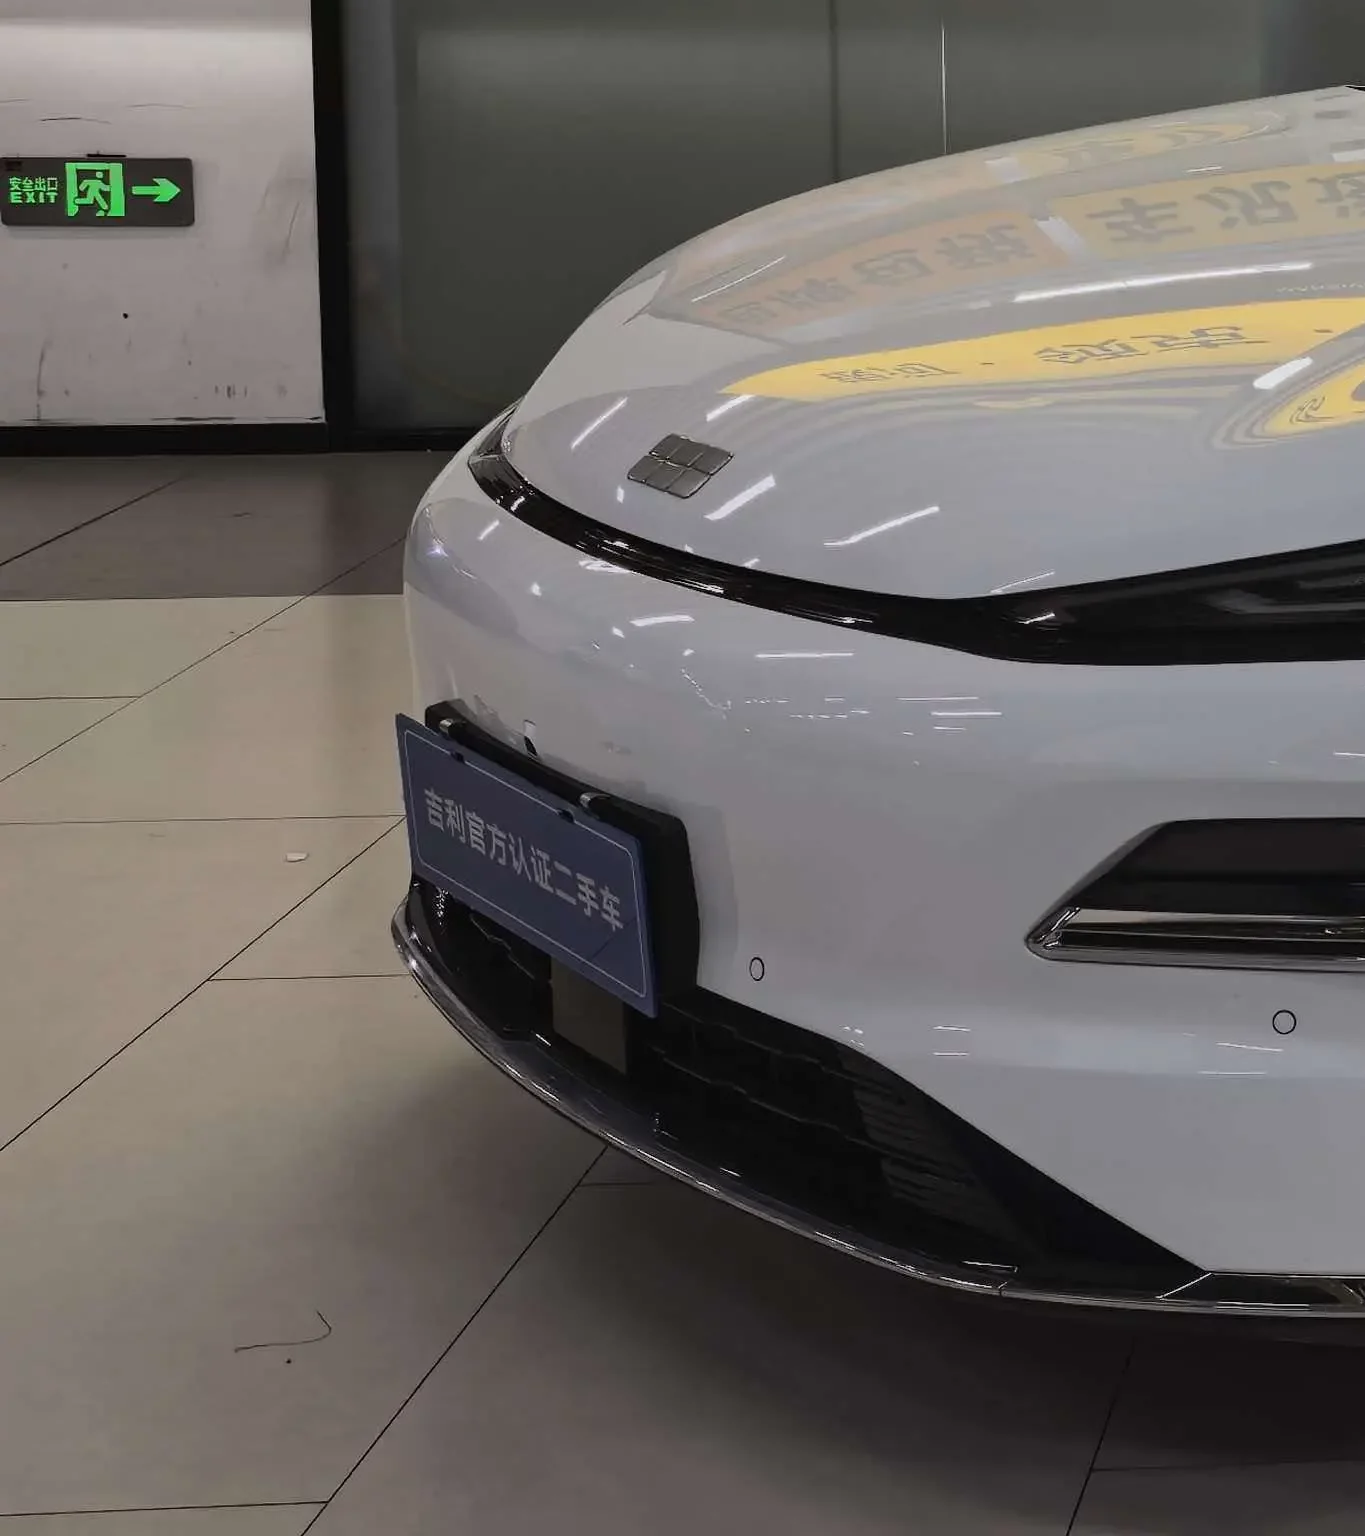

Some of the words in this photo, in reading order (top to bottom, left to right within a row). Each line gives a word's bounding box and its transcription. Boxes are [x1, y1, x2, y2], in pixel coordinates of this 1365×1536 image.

[9, 177, 58, 192] 安全出口
[10, 192, 58, 204] EXIT
[424, 787, 623, 932] 吉利官方认证二手车
